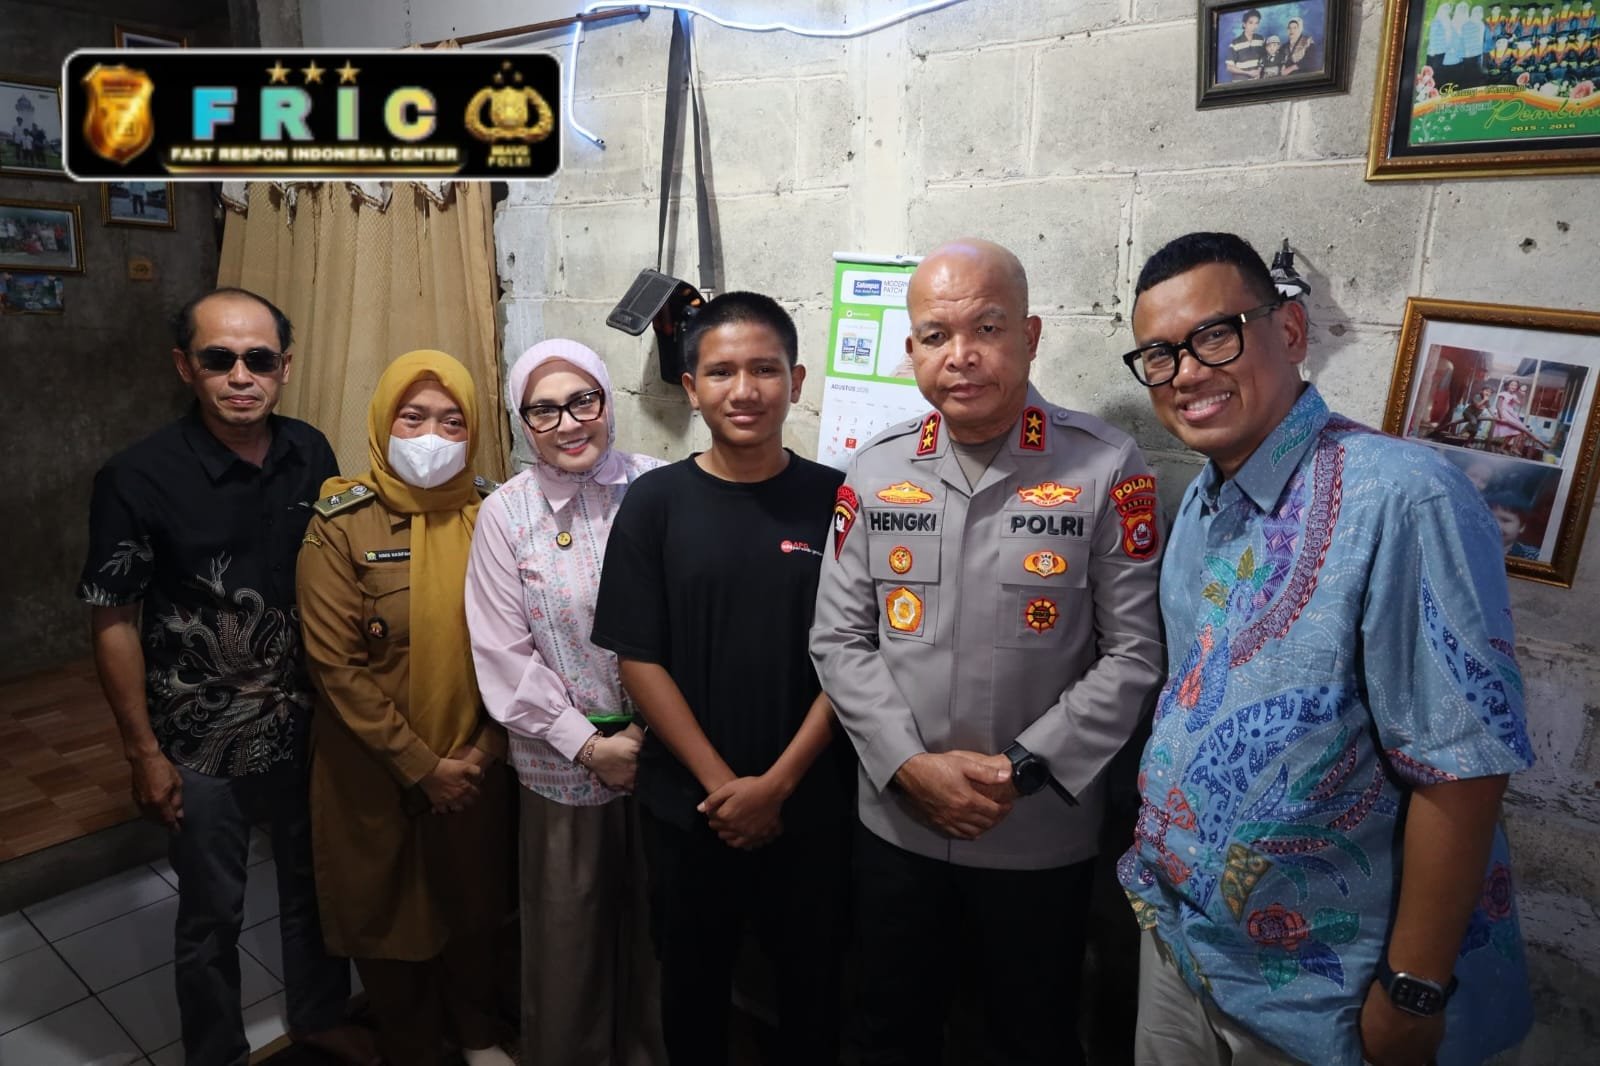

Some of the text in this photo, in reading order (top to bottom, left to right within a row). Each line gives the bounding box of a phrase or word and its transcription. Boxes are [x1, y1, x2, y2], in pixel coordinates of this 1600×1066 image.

[1114, 478, 1153, 501] POLDA
[870, 511, 937, 531] HENGKI
[1010, 515, 1084, 537] POLRI
